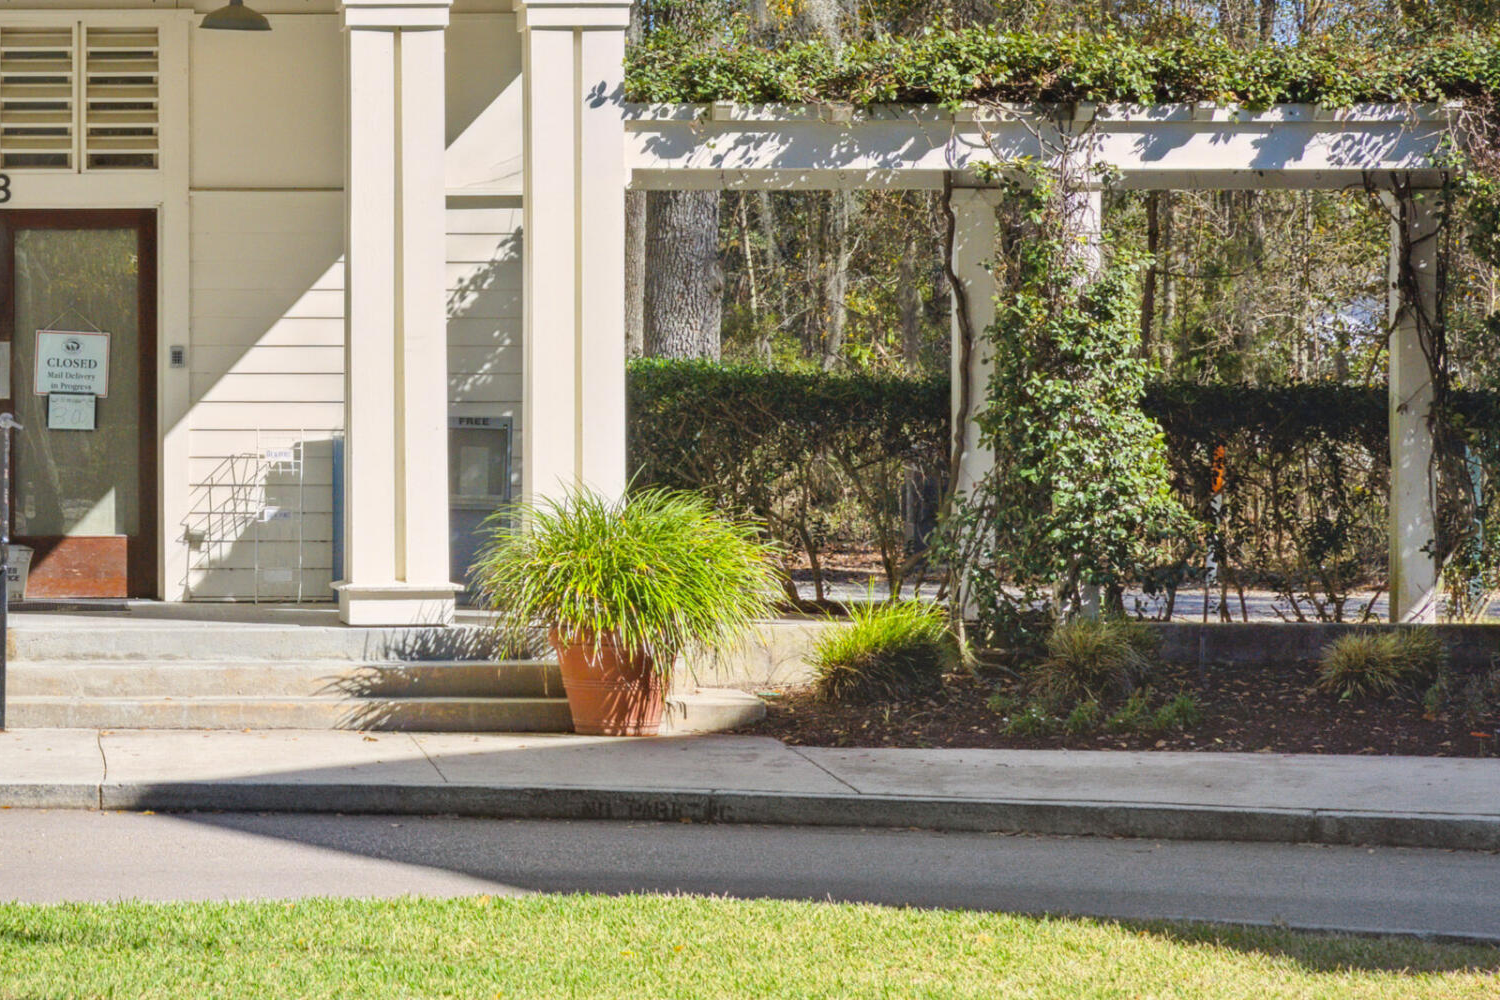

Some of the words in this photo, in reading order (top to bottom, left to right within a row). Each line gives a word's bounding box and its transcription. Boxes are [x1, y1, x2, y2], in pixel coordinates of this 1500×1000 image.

[46, 357, 98, 370] CLOSED
[47, 371, 63, 379] Mail
[65, 372, 96, 382] Delivery
[60, 382, 92, 391] Progress
[459, 417, 490, 425] FREE
